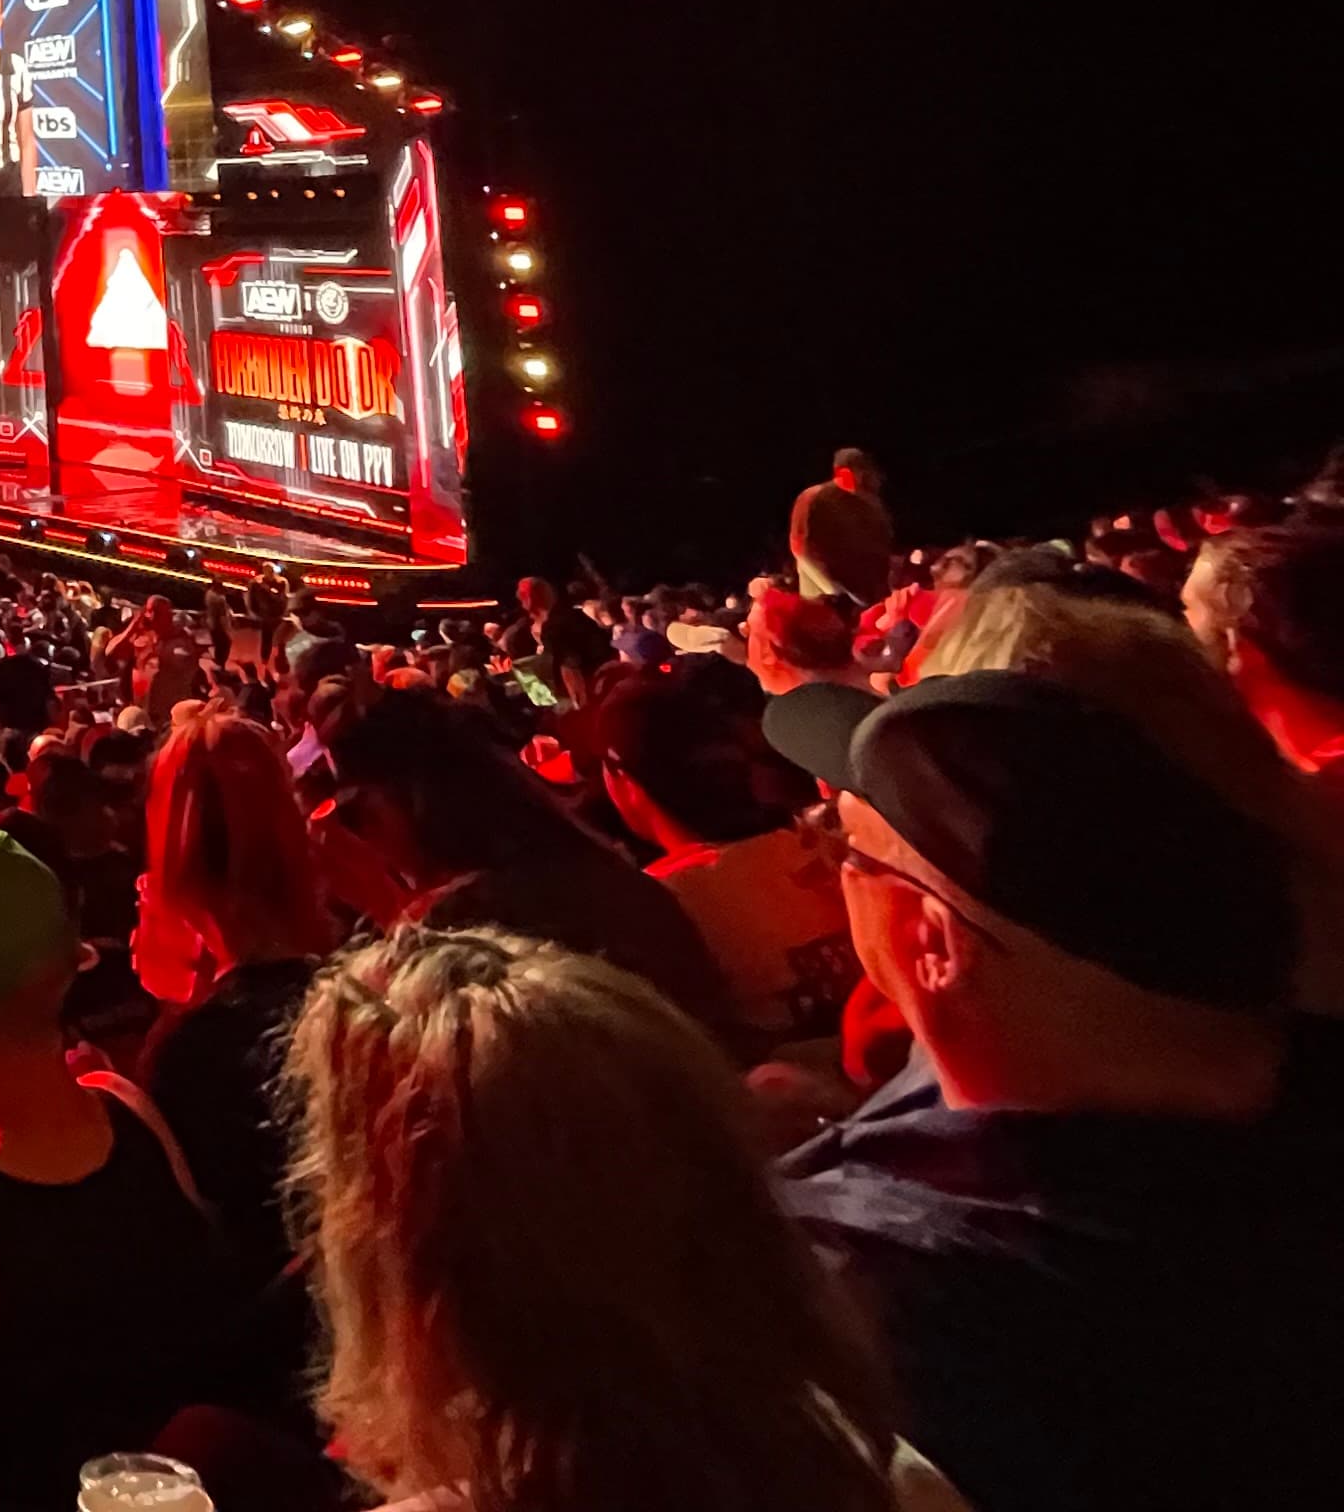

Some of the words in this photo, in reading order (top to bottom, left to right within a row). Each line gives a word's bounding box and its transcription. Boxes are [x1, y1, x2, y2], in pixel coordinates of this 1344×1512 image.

[28, 39, 70, 64] AEW
[37, 114, 71, 132] tbs
[36, 172, 82, 195] AEW
[246, 287, 297, 316] AEW
[214, 335, 312, 405] FORBIDDEN
[313, 337, 398, 418] DOOR
[226, 421, 296, 470] TOMORROW
[309, 434, 338, 478] LIVE
[339, 438, 362, 482] ON
[362, 443, 394, 489] PPV
